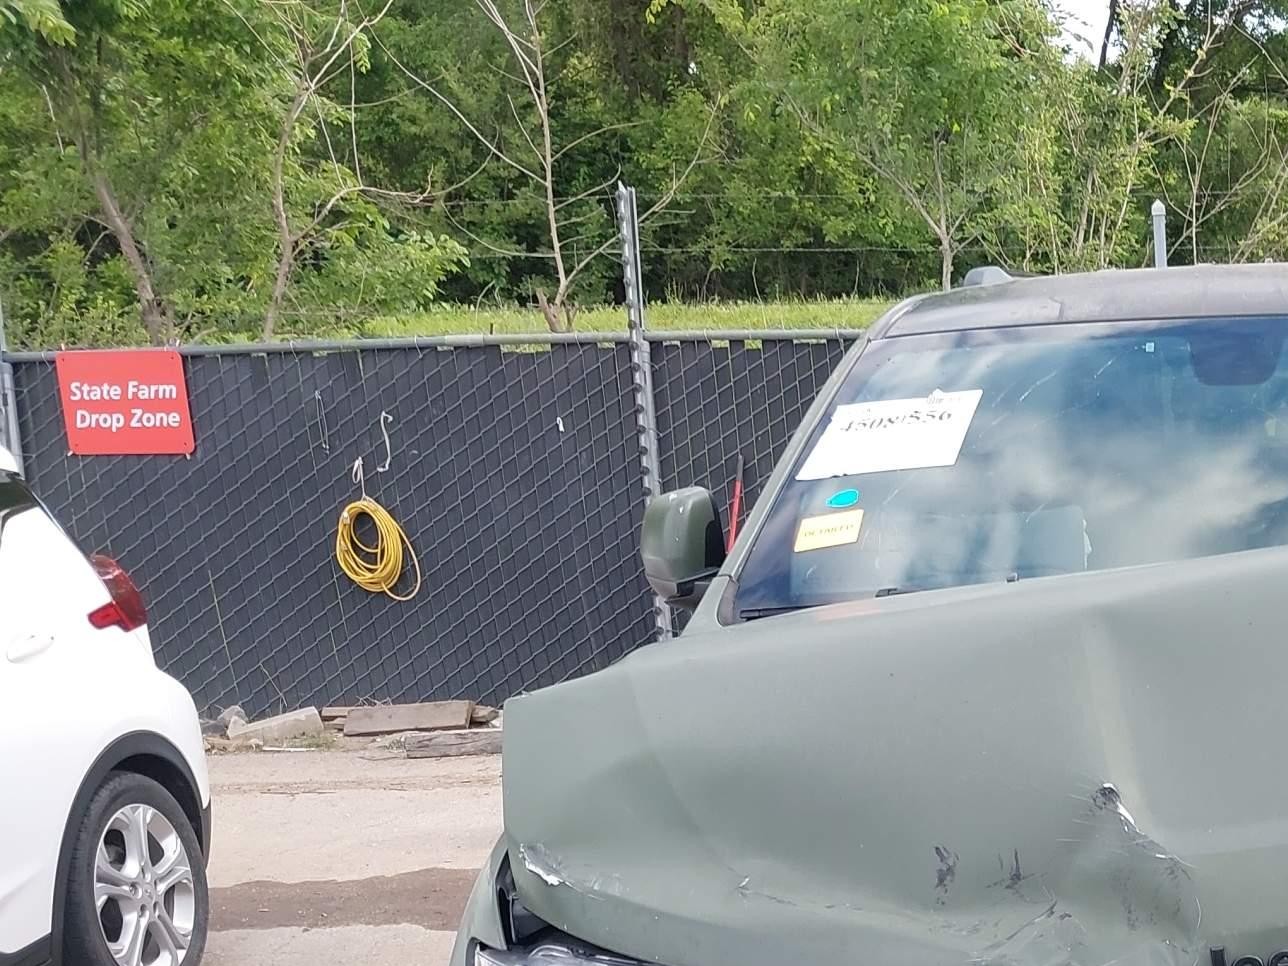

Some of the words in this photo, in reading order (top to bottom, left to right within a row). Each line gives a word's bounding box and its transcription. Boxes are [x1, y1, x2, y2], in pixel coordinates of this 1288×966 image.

[69, 382, 122, 400] State
[127, 381, 177, 399] Farm
[76, 409, 125, 432] Drop
[129, 409, 181, 427] Zone
